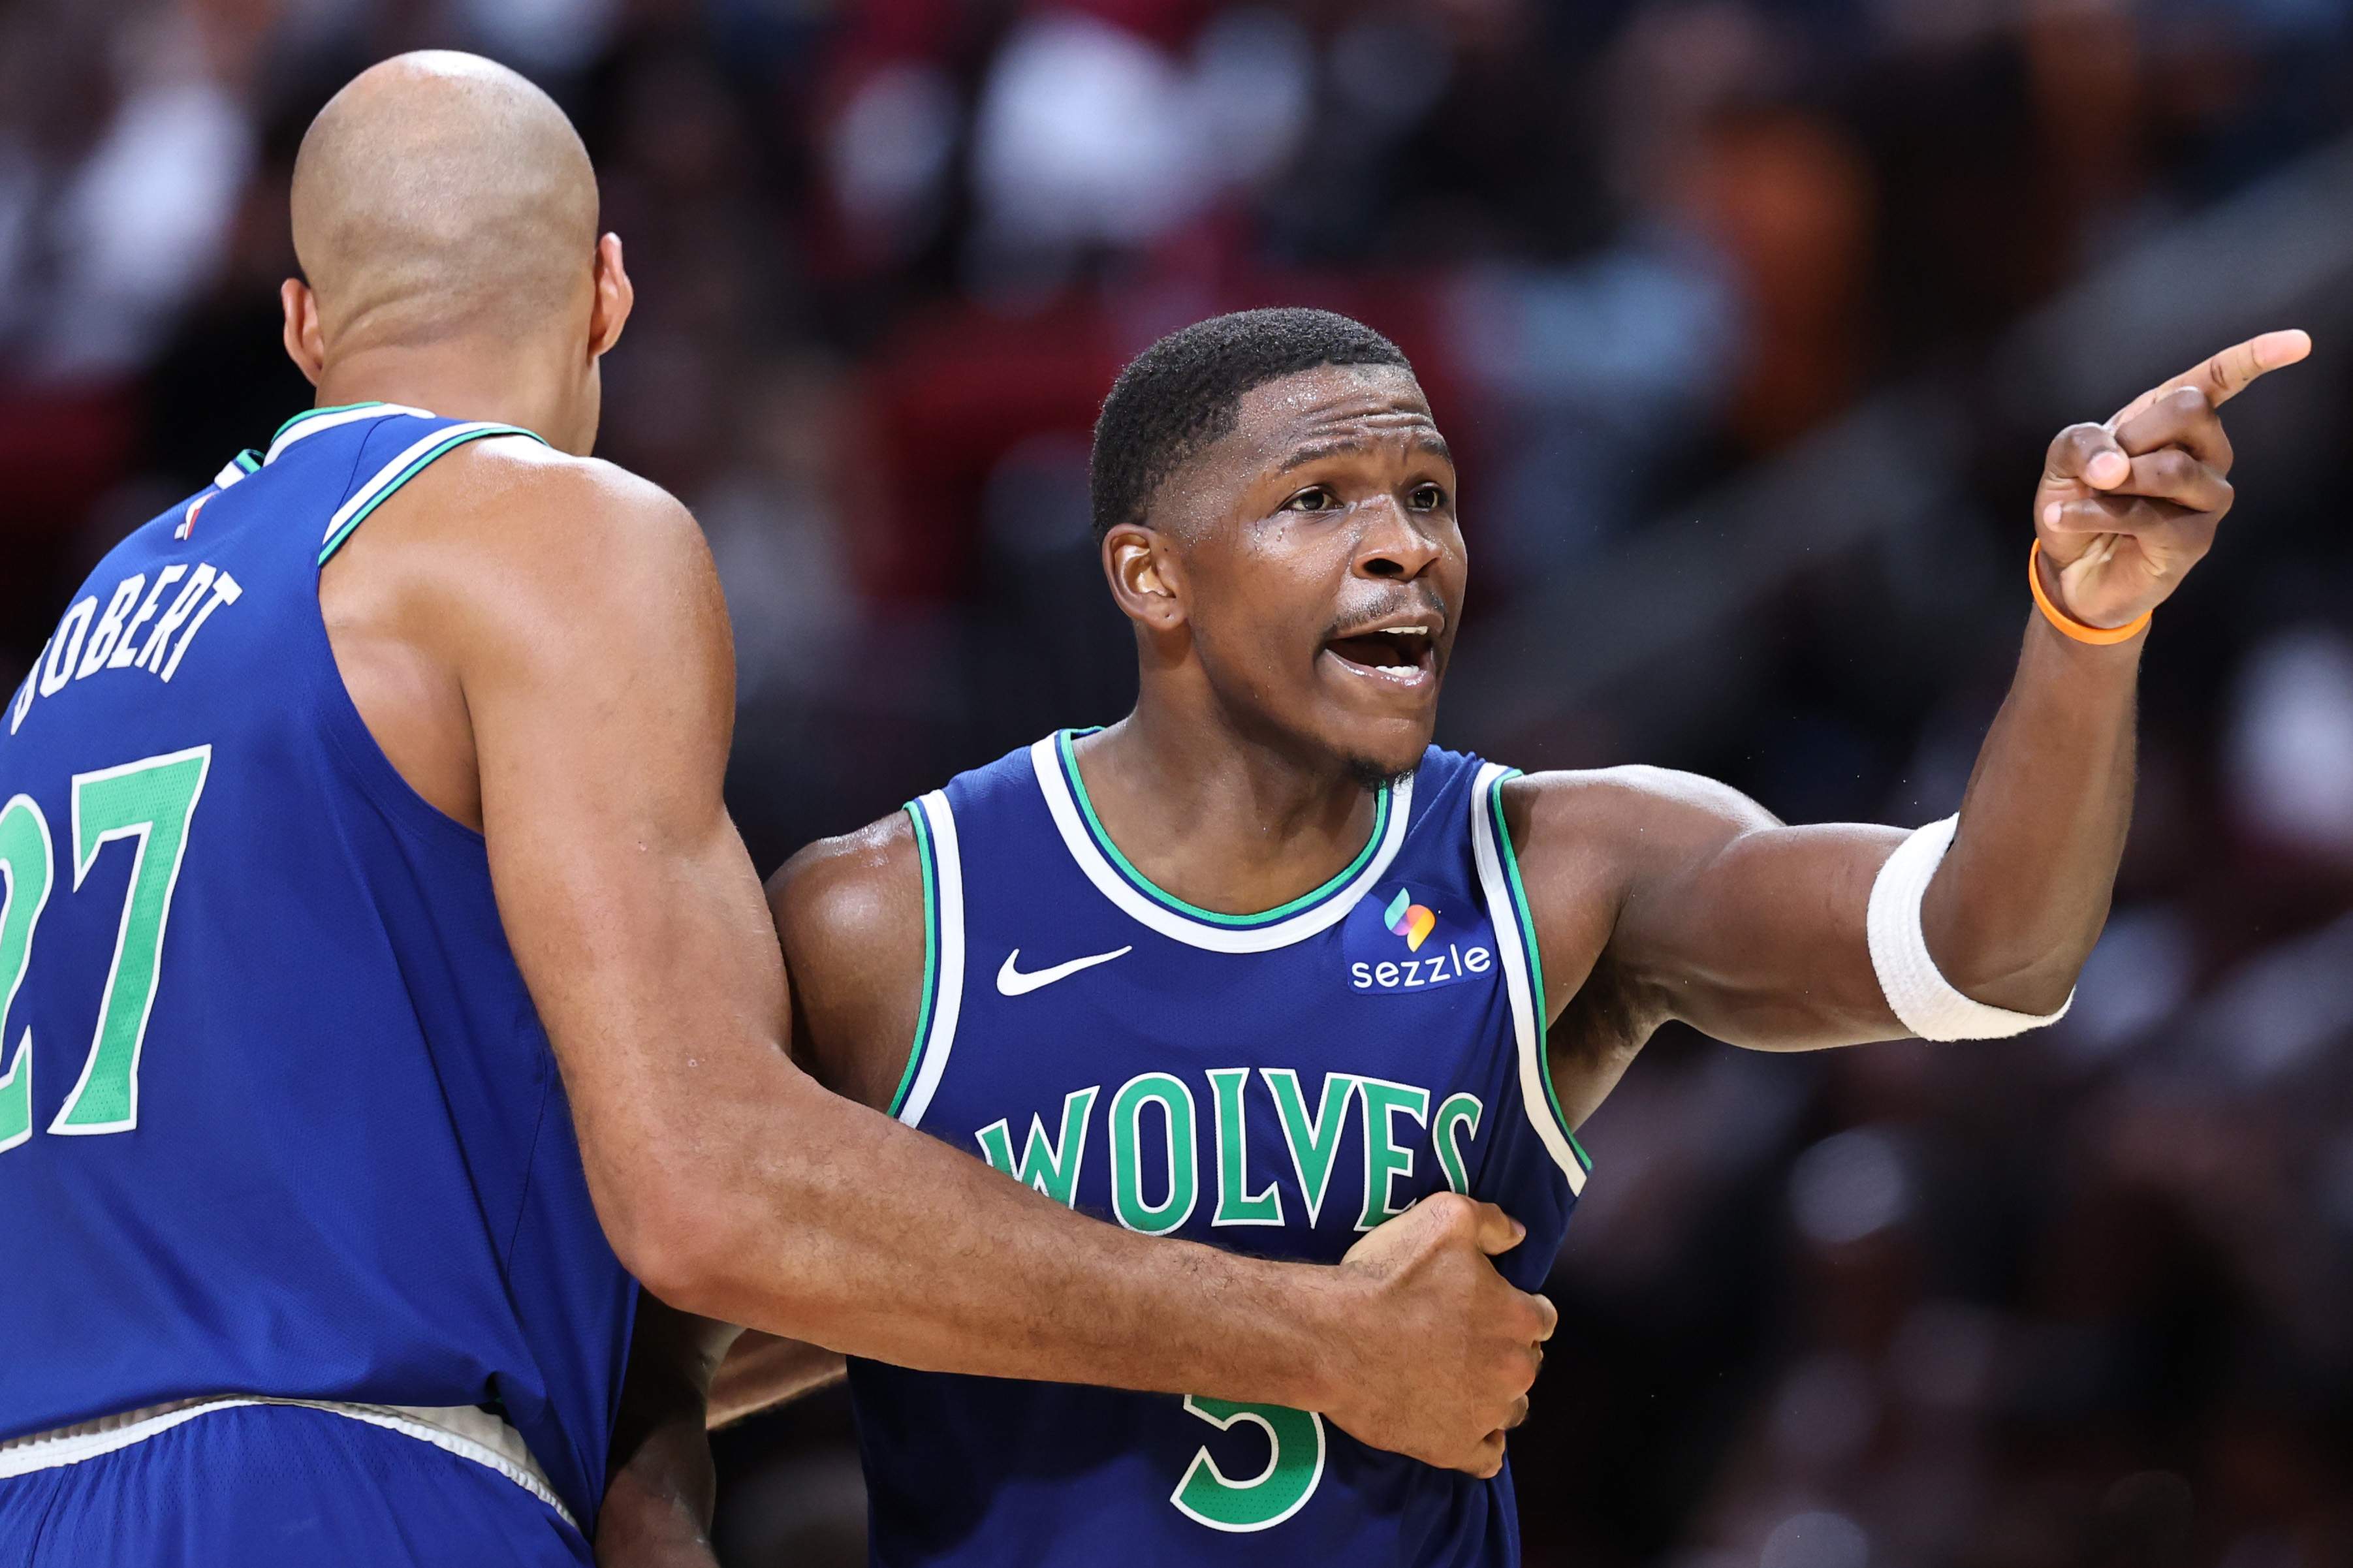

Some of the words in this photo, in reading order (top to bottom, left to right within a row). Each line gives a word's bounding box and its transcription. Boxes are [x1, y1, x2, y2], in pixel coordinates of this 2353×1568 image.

[1351, 943, 1491, 988] sezzle
[975, 1067, 1483, 1236] WOLVES
[1169, 1394, 1326, 1533] 5
